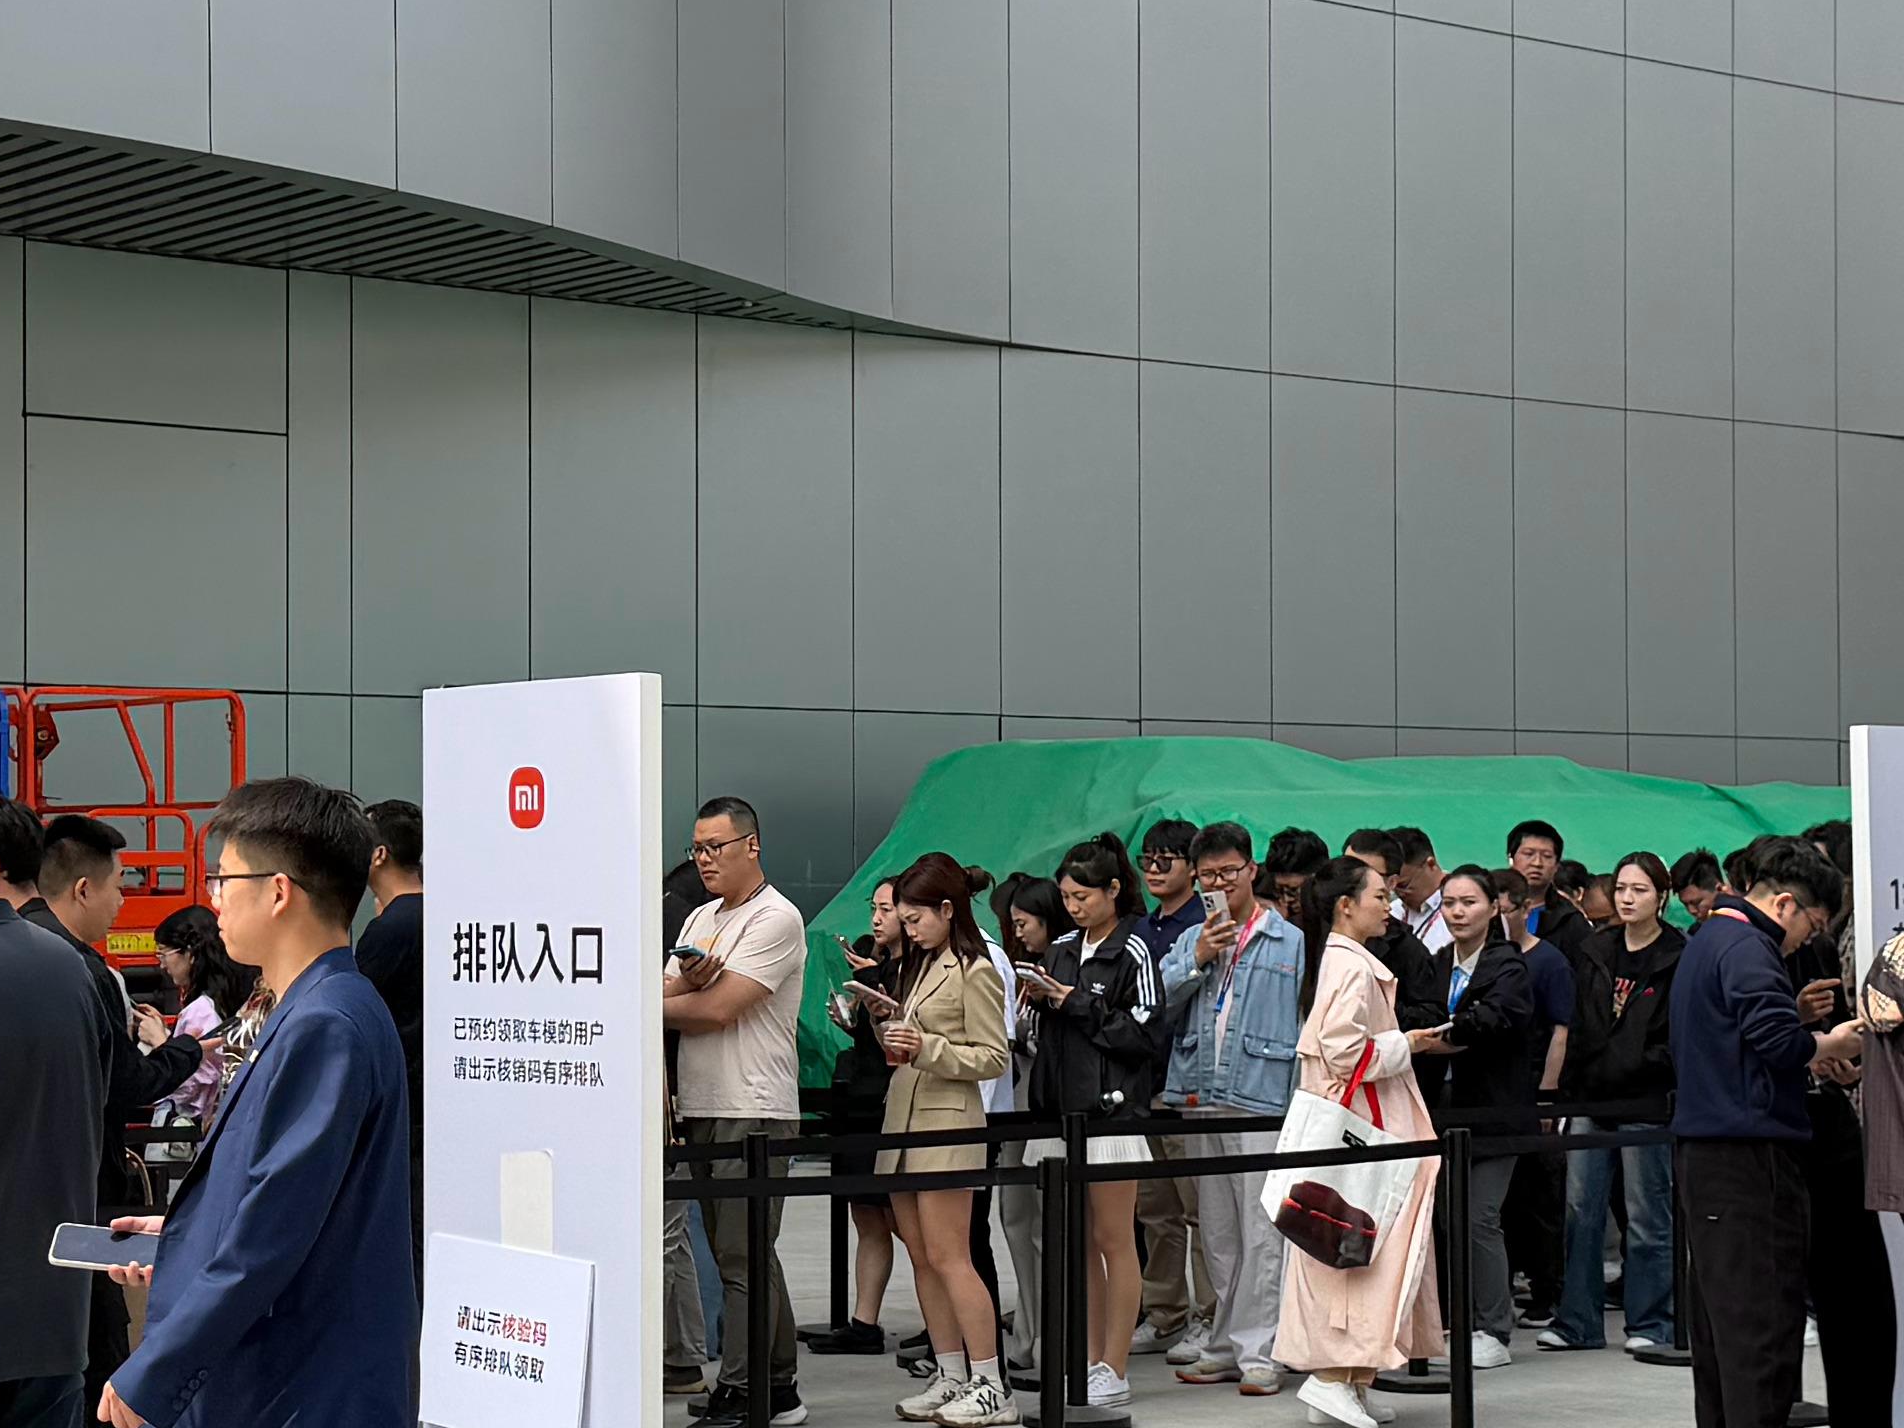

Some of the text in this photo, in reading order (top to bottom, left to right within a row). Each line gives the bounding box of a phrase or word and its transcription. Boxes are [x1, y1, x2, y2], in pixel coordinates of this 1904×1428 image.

[452, 921, 603, 984] 排队入口
[453, 1016, 605, 1046] 已预约领取车模的用户
[453, 1055, 605, 1087] 请出示核销码有序排队
[457, 1304, 547, 1347] 请出示核验码
[454, 1340, 545, 1384] 有序排队领取
